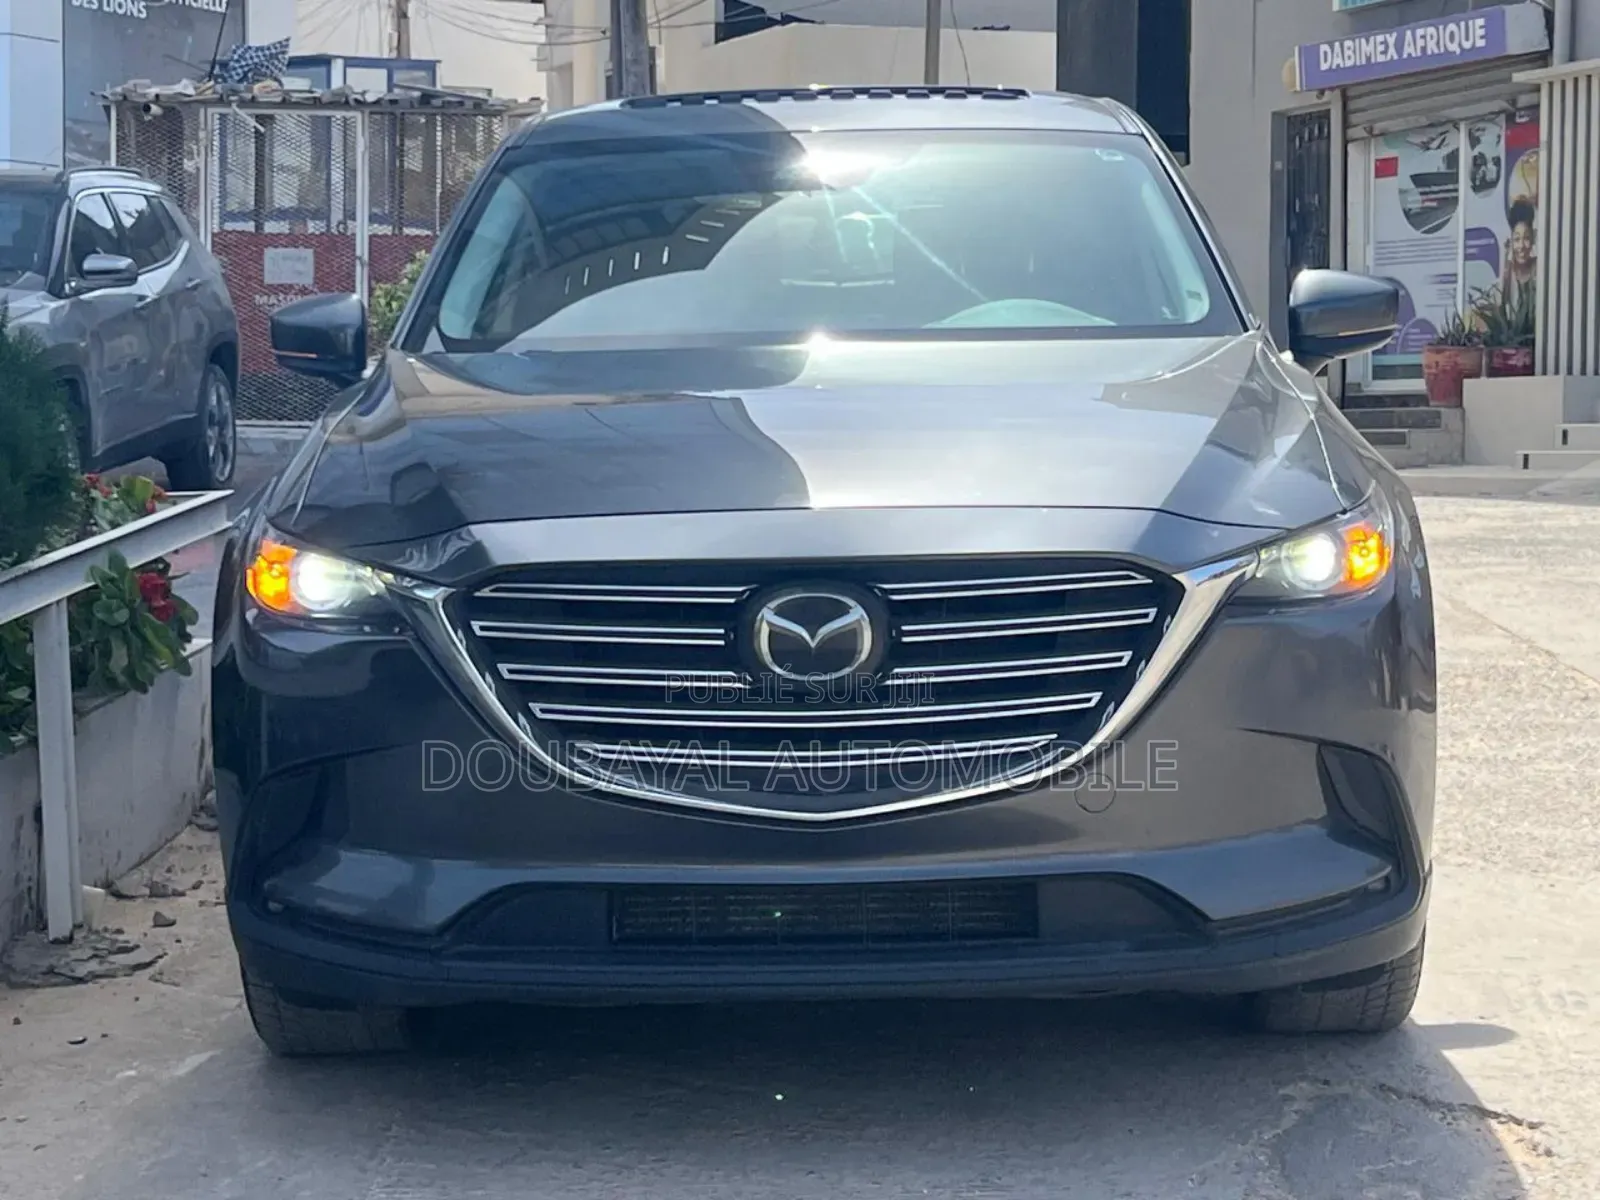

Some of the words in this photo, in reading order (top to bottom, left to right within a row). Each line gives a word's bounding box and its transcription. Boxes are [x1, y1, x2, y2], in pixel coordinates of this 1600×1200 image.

[103, 0, 147, 19] LIONS
[1319, 31, 1398, 71] DABIMEX
[1402, 18, 1487, 55] AFRIQUE
